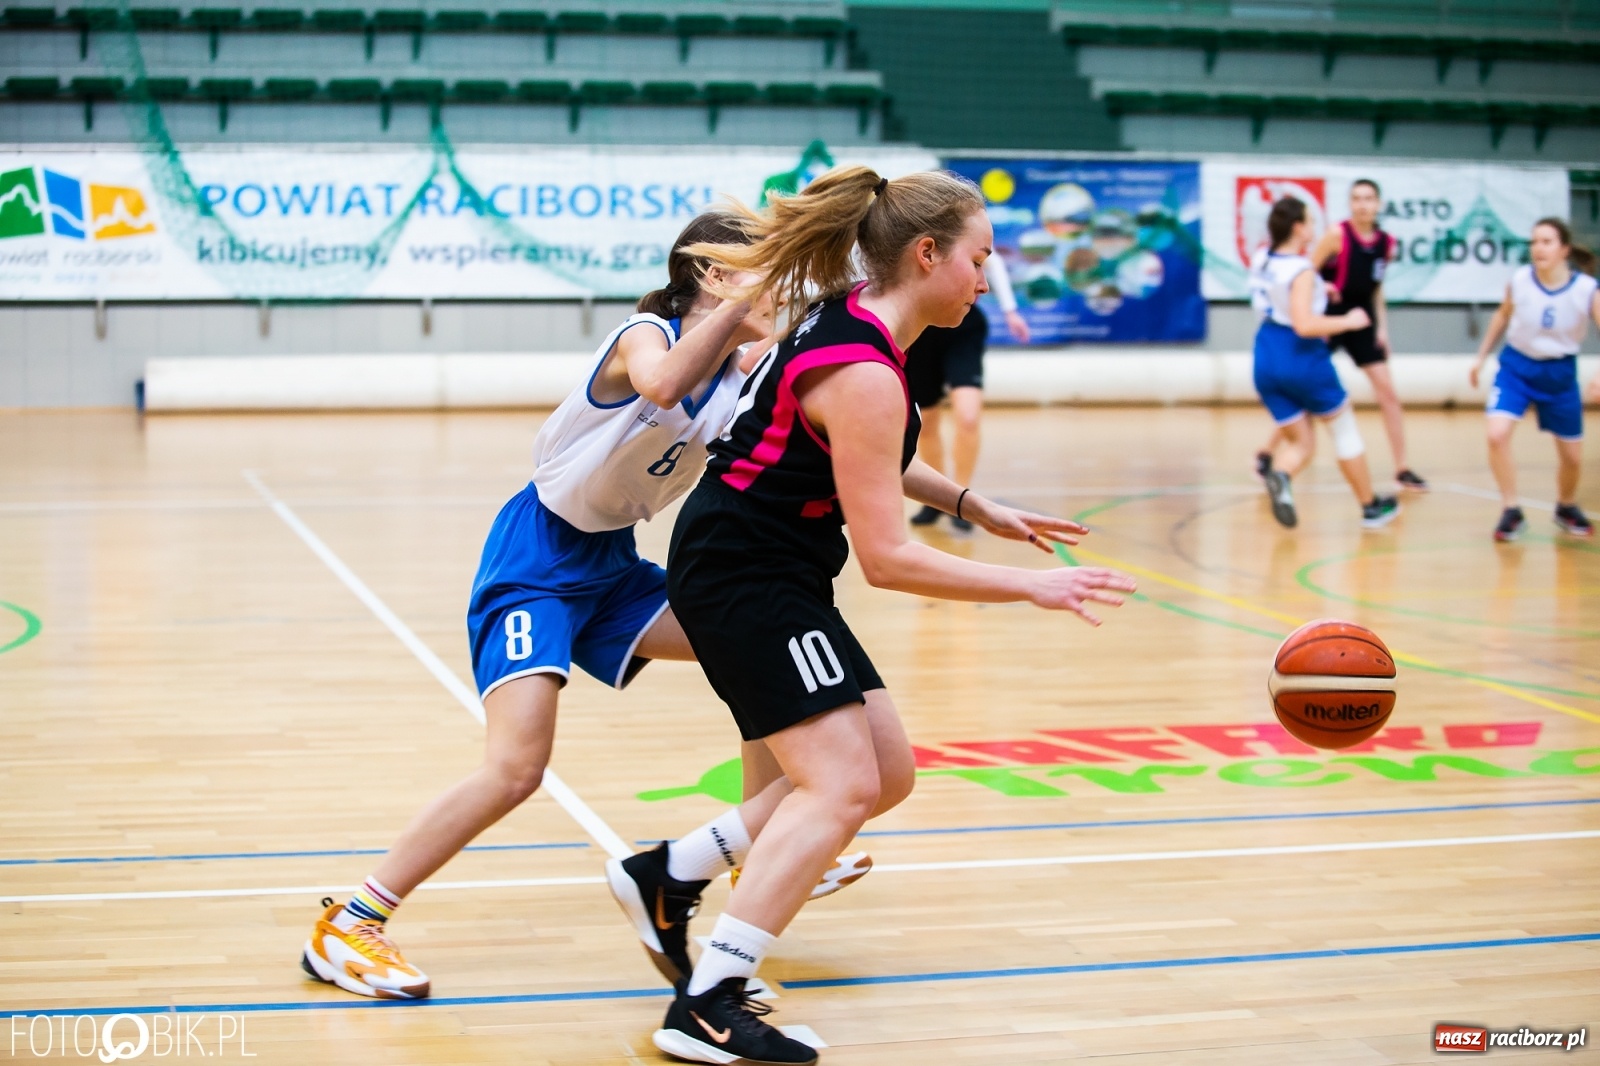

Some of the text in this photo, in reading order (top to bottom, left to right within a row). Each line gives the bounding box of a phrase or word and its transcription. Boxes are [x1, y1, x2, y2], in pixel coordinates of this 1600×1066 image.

[200, 183, 402, 218] POWIAT
[1382, 200, 1453, 221] ASTO
[198, 238, 670, 271] kibicujemy, wspieramy, gra
[646, 440, 688, 477] 8
[503, 609, 534, 661] 8
[787, 629, 846, 694] 10
[1303, 702, 1380, 721] molten
[710, 826, 737, 867] adidas
[709, 939, 757, 964] adidas
